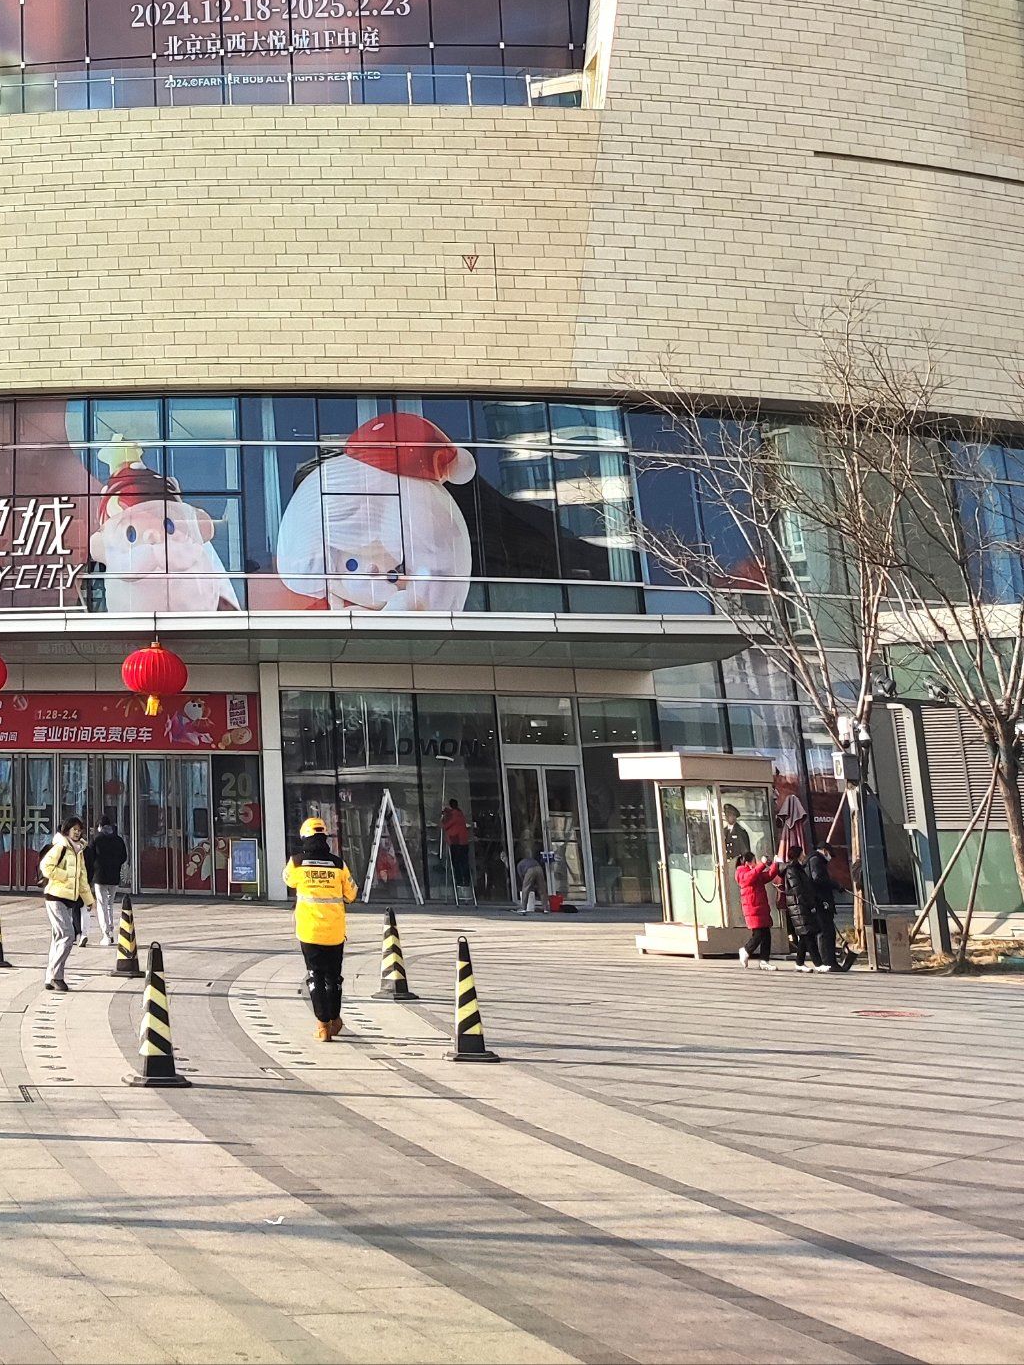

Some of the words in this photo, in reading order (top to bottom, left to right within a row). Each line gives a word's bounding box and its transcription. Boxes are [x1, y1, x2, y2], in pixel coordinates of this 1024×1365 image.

[163, 26, 381, 61] 北京京西大悦城1F中庭
[266, 74, 285, 83] ALL
[287, 73, 325, 82] IGHTS
[328, 71, 381, 81] RESRED
[37, 710, 78, 720] 1.28-2.4
[33, 726, 152, 743] 营业时间免费停车
